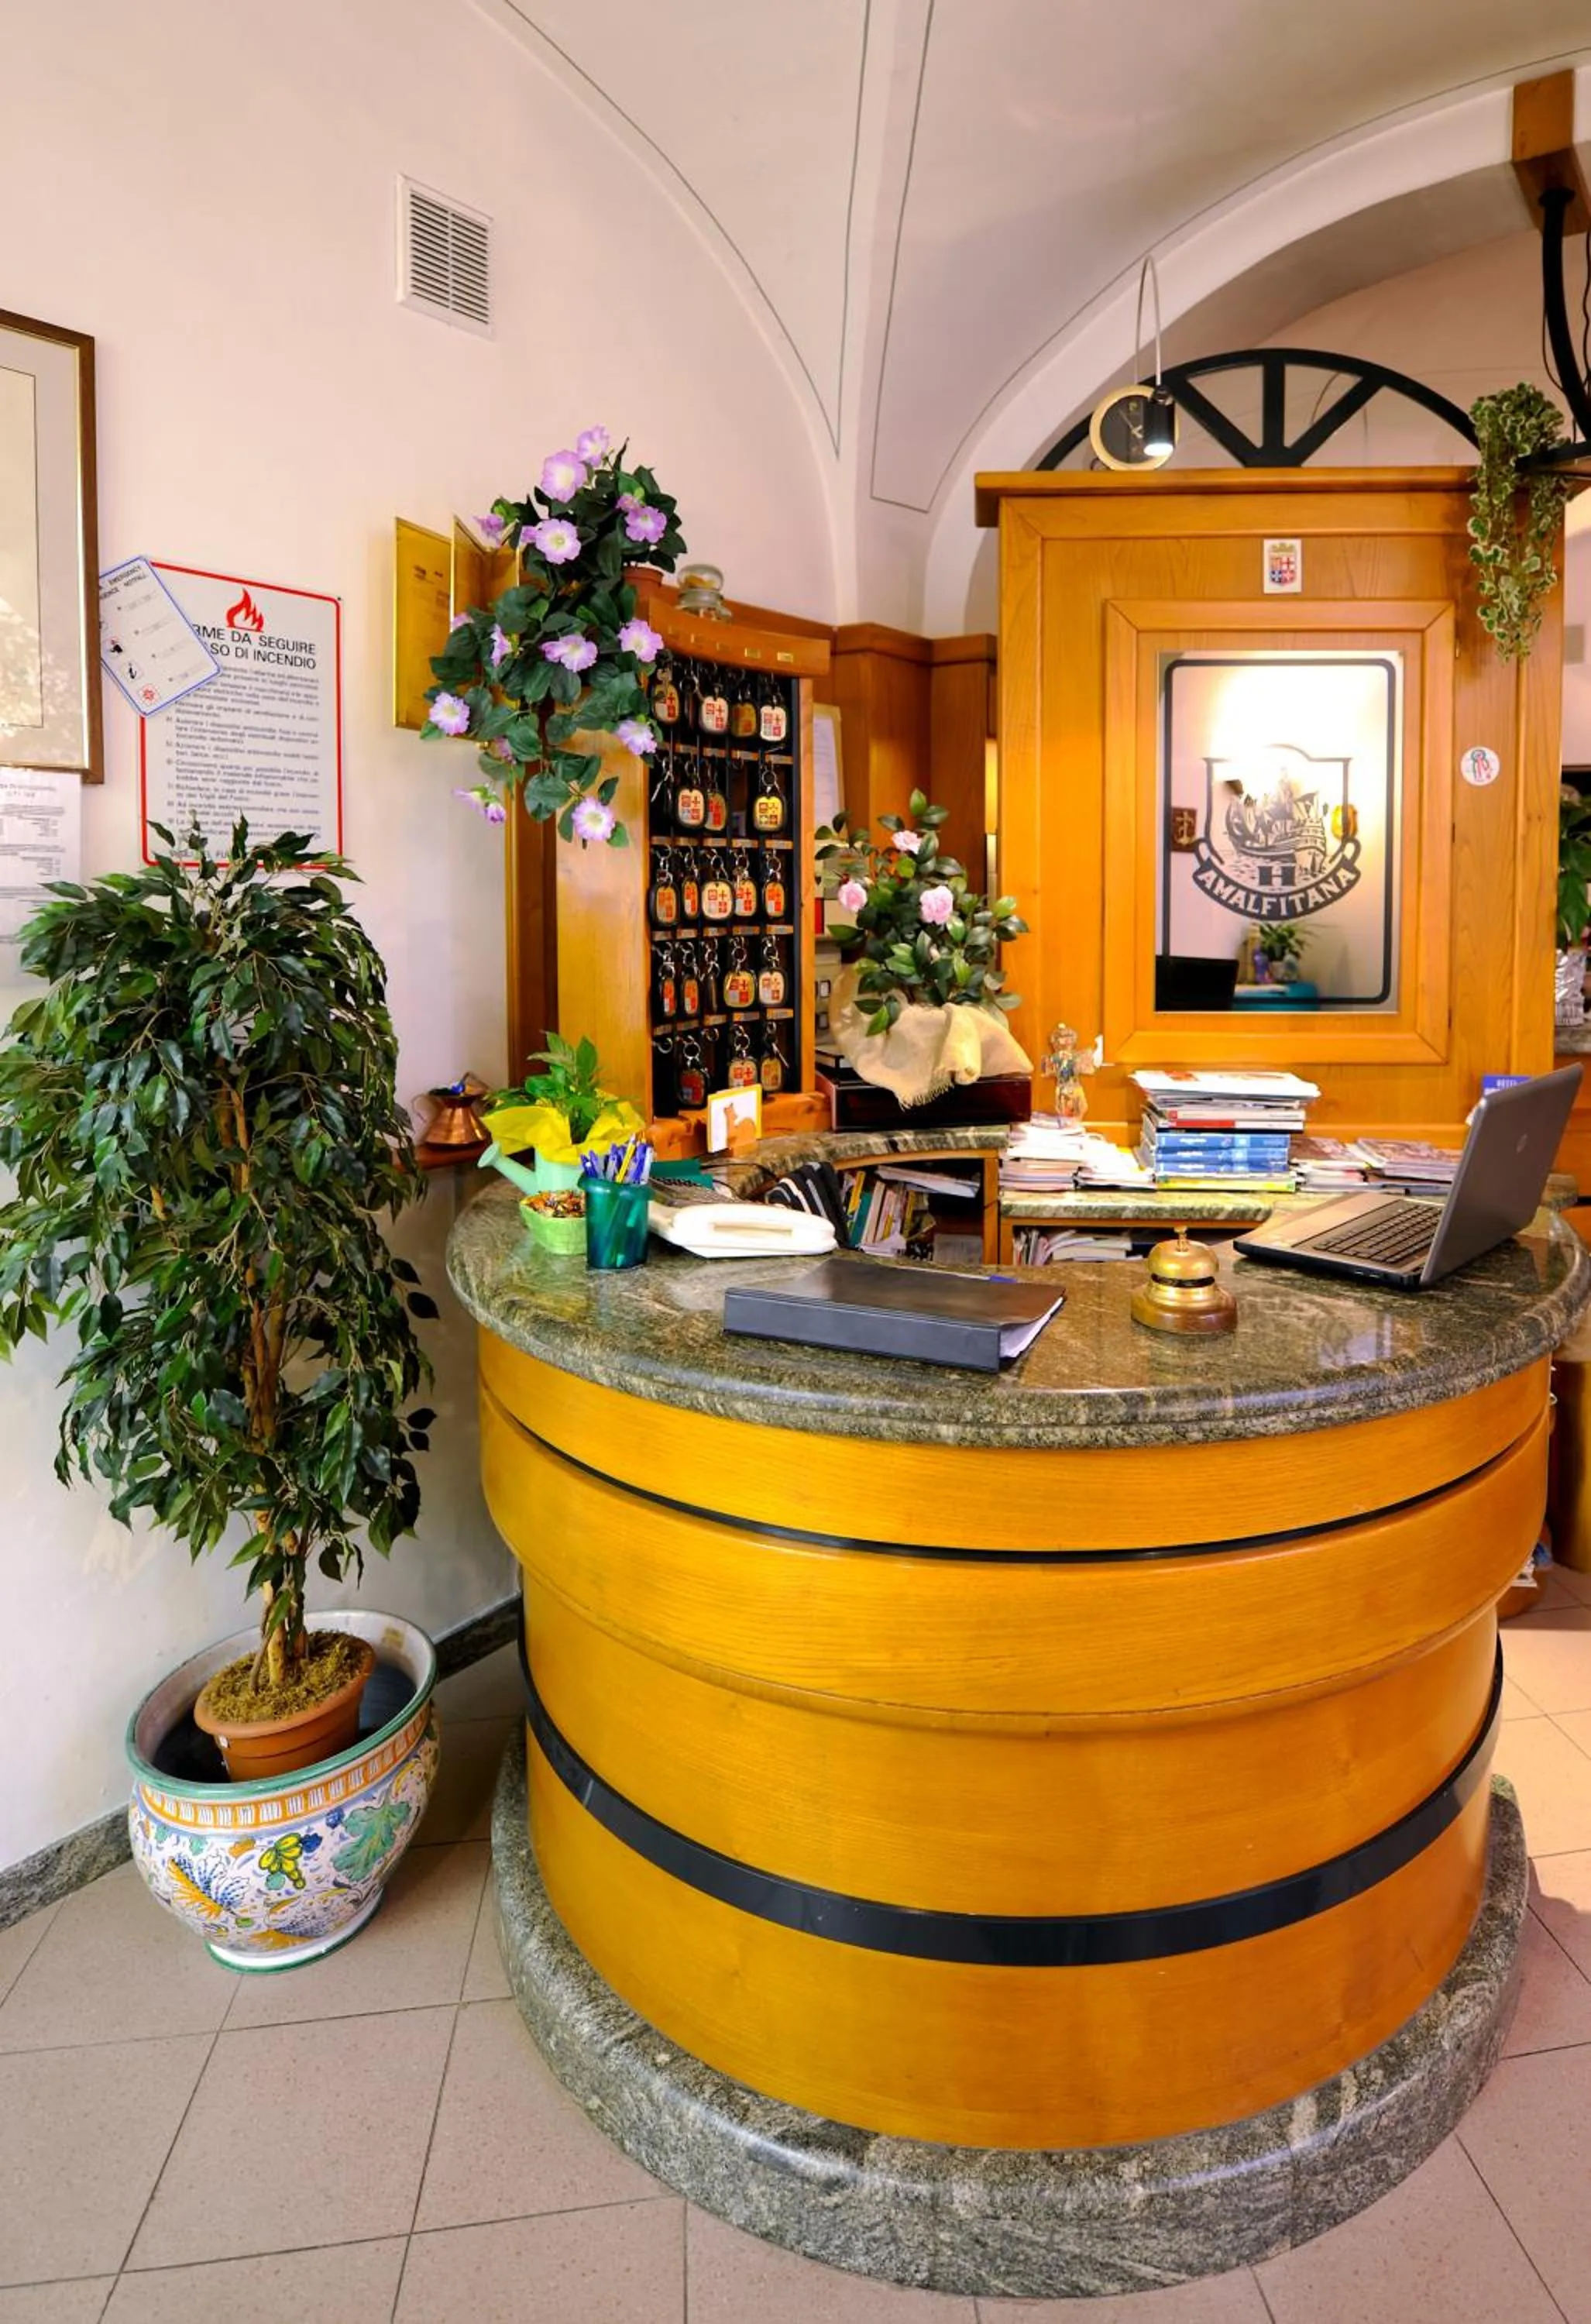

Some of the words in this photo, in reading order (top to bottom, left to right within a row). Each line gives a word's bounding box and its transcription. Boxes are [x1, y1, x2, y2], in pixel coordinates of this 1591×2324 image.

[192, 624, 225, 641] RME
[231, 631, 252, 645] DA
[259, 634, 317, 655] SEGUIRE
[210, 642, 230, 656] SO
[235, 647, 249, 659] DI
[253, 649, 317, 670] INCENDIO
[1198, 867, 1356, 916] AMALFITANA
